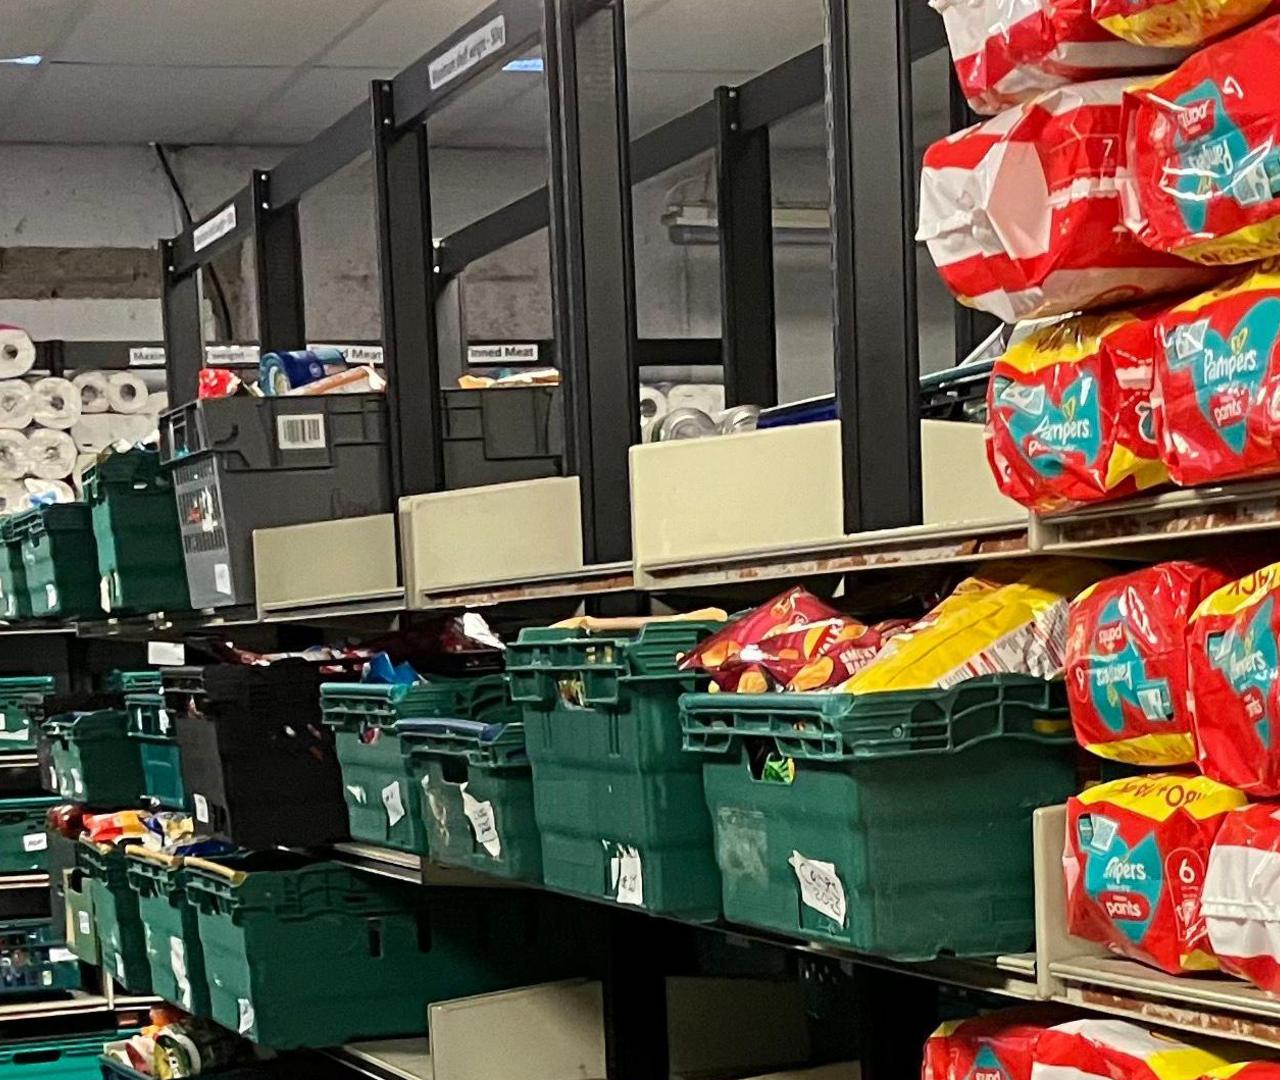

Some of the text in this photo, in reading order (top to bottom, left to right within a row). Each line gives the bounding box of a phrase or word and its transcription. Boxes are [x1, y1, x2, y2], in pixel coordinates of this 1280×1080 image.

[351, 349, 383, 361] Meat
[504, 348, 534, 358] Meat
[1204, 348, 1258, 383] Pampers
[1179, 857, 1196, 884] 6
[1106, 901, 1142, 917] pants
